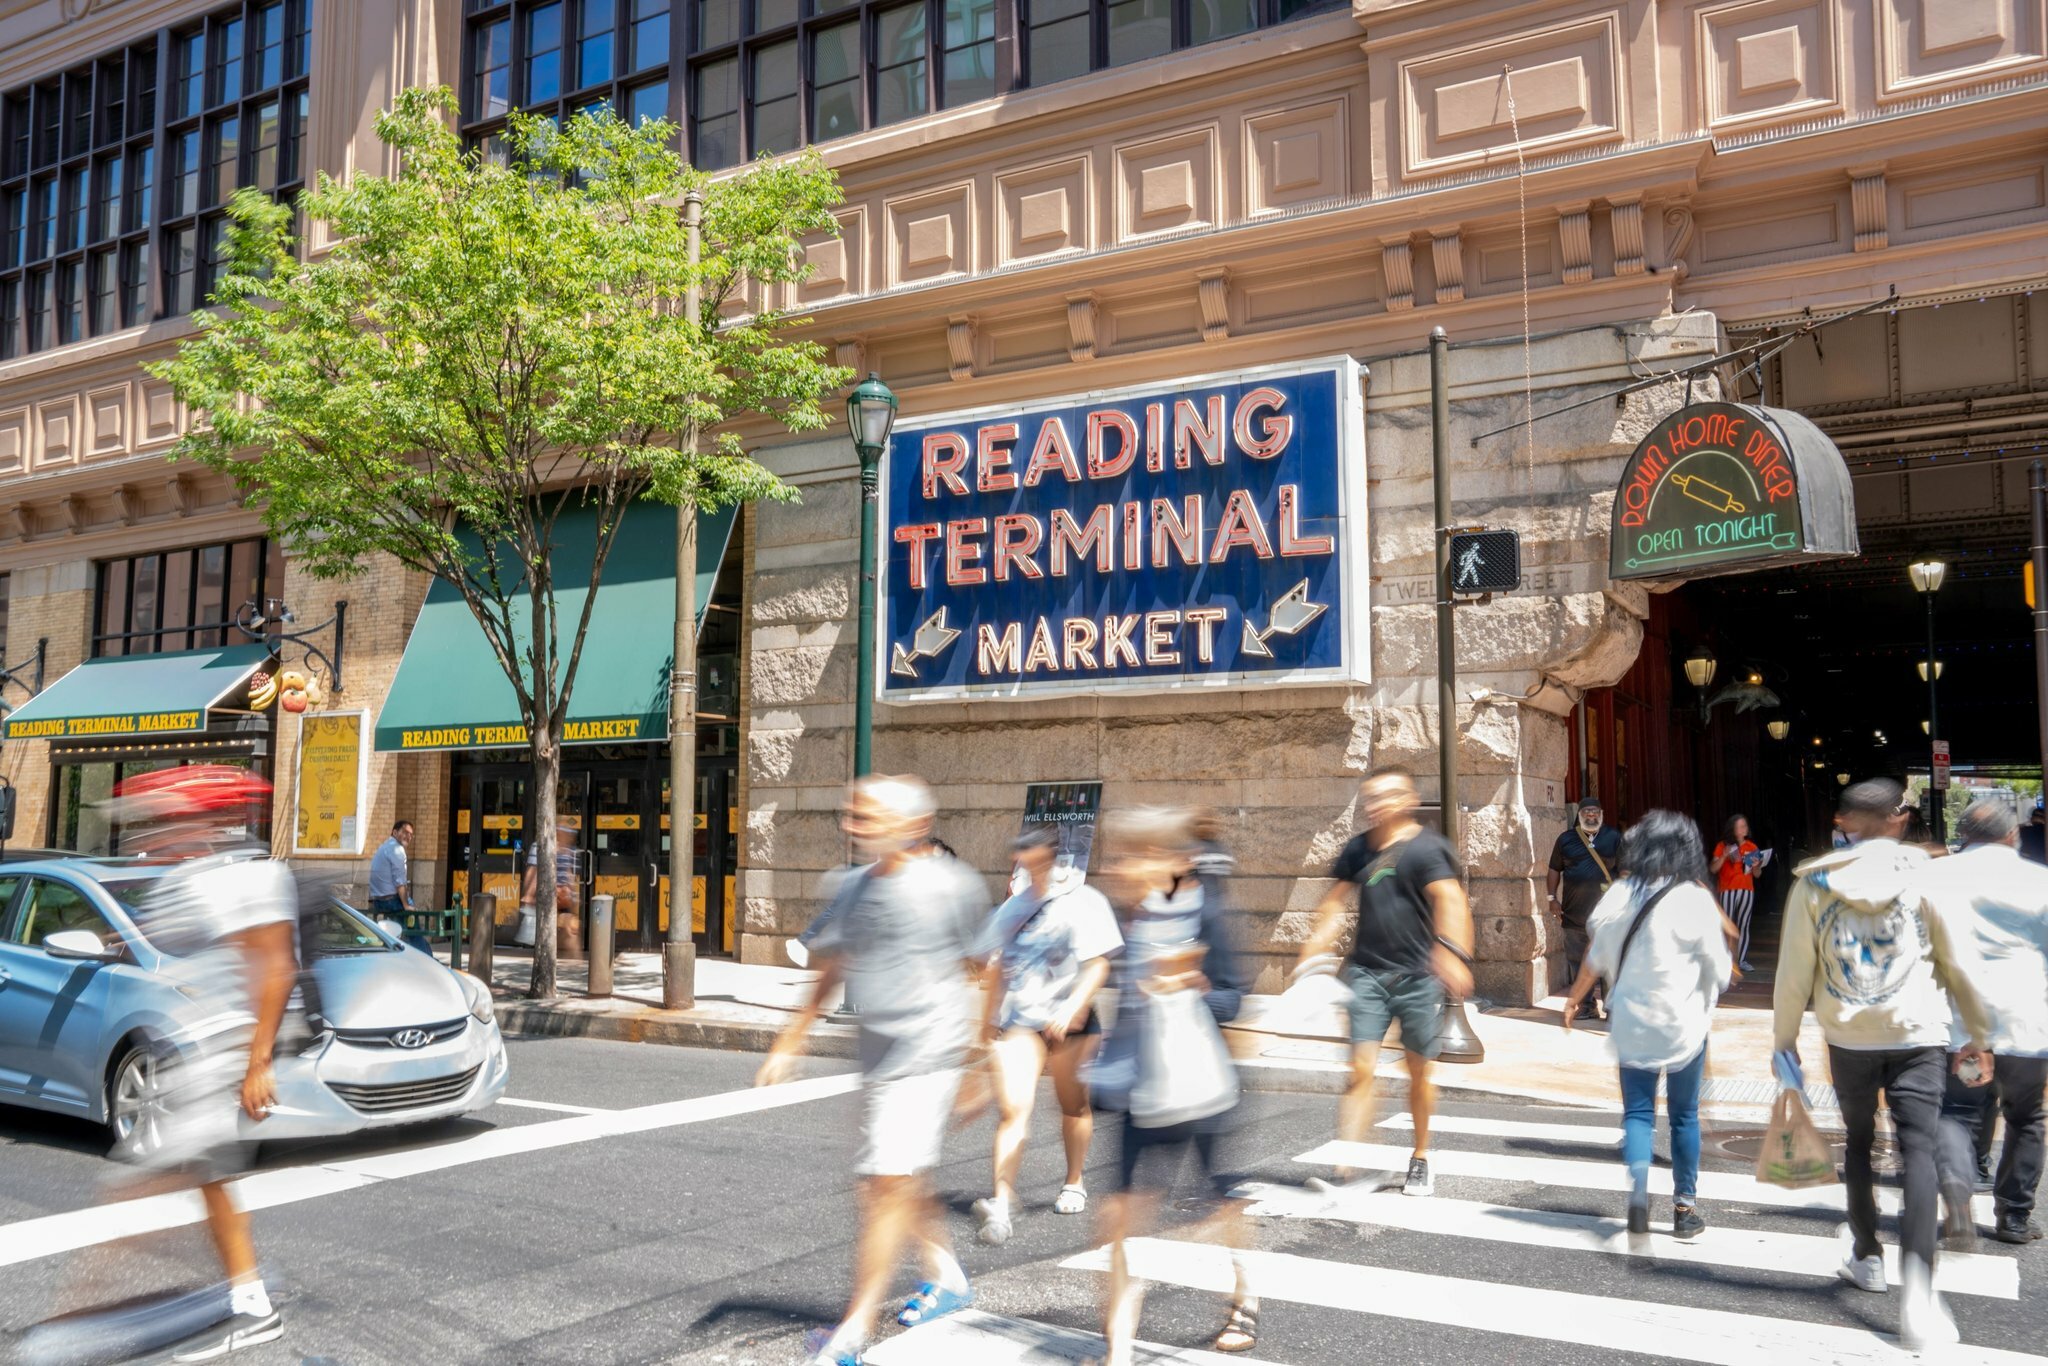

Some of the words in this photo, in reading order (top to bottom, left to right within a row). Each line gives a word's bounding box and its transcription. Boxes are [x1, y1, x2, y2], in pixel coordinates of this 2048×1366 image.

[922, 386, 1293, 499] READING
[1621, 445, 1668, 526] DOWN
[1669, 414, 1746, 455] HOME
[1744, 429, 1793, 503] DINER
[894, 484, 1335, 589] TERMINAL
[1637, 528, 1684, 555] OPEN
[1694, 513, 1777, 546] TONIGHT
[978, 607, 1227, 675] MARKET
[8, 719, 65, 738] READING
[67, 716, 135, 735] TERMINAL
[138, 712, 199, 732] MARKET
[402, 728, 470, 747] READING
[474, 725, 529, 744] TERMI
[563, 719, 640, 740] MARKET
[1043, 812, 1095, 822] ELLSWORTH
